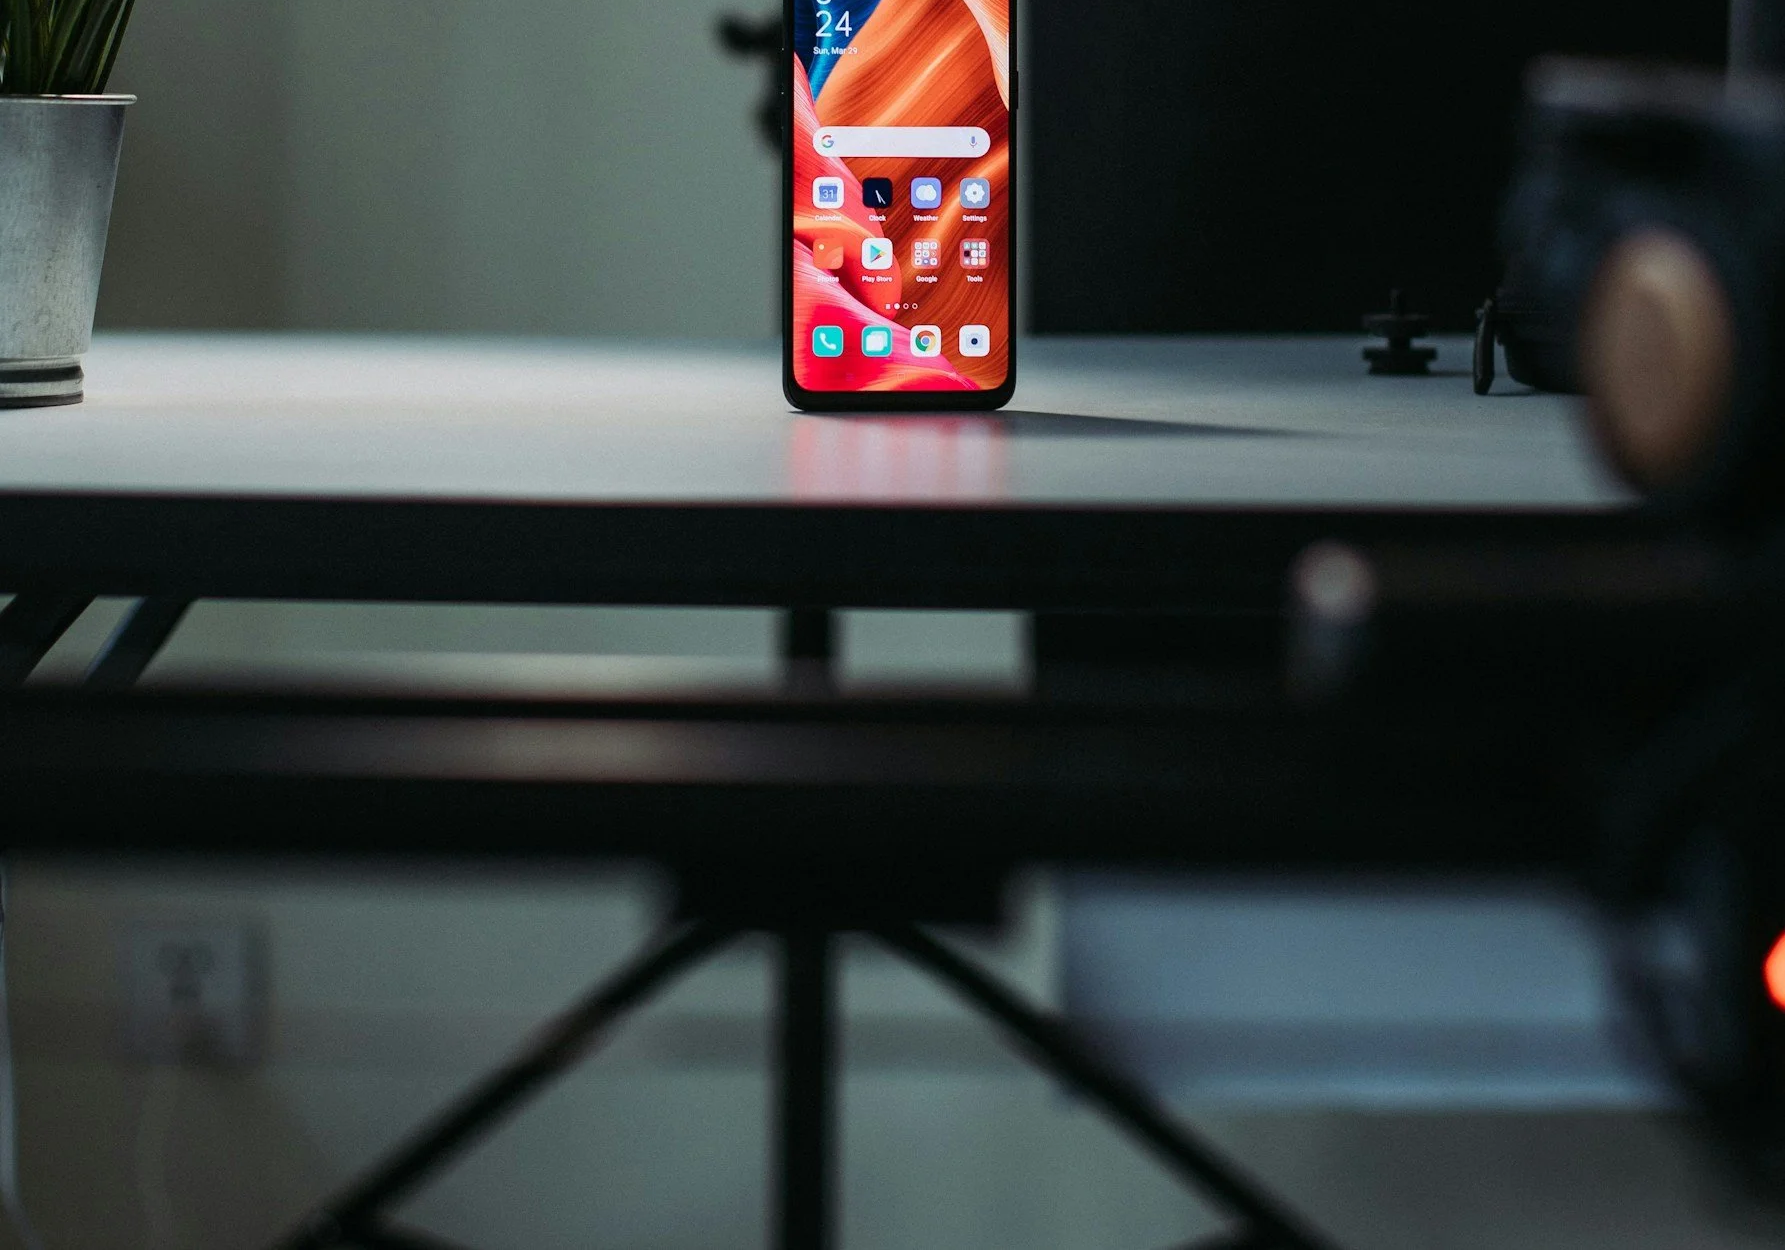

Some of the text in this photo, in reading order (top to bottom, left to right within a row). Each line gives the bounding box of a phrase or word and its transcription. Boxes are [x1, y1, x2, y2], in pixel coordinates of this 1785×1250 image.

[815, 10, 853, 37] 24
[813, 46, 830, 55] Sun,
[822, 189, 834, 199] 31
[962, 215, 988, 223] Settings
[861, 275, 875, 283] Play
[916, 275, 938, 283] Google
[966, 275, 984, 283] Tools
